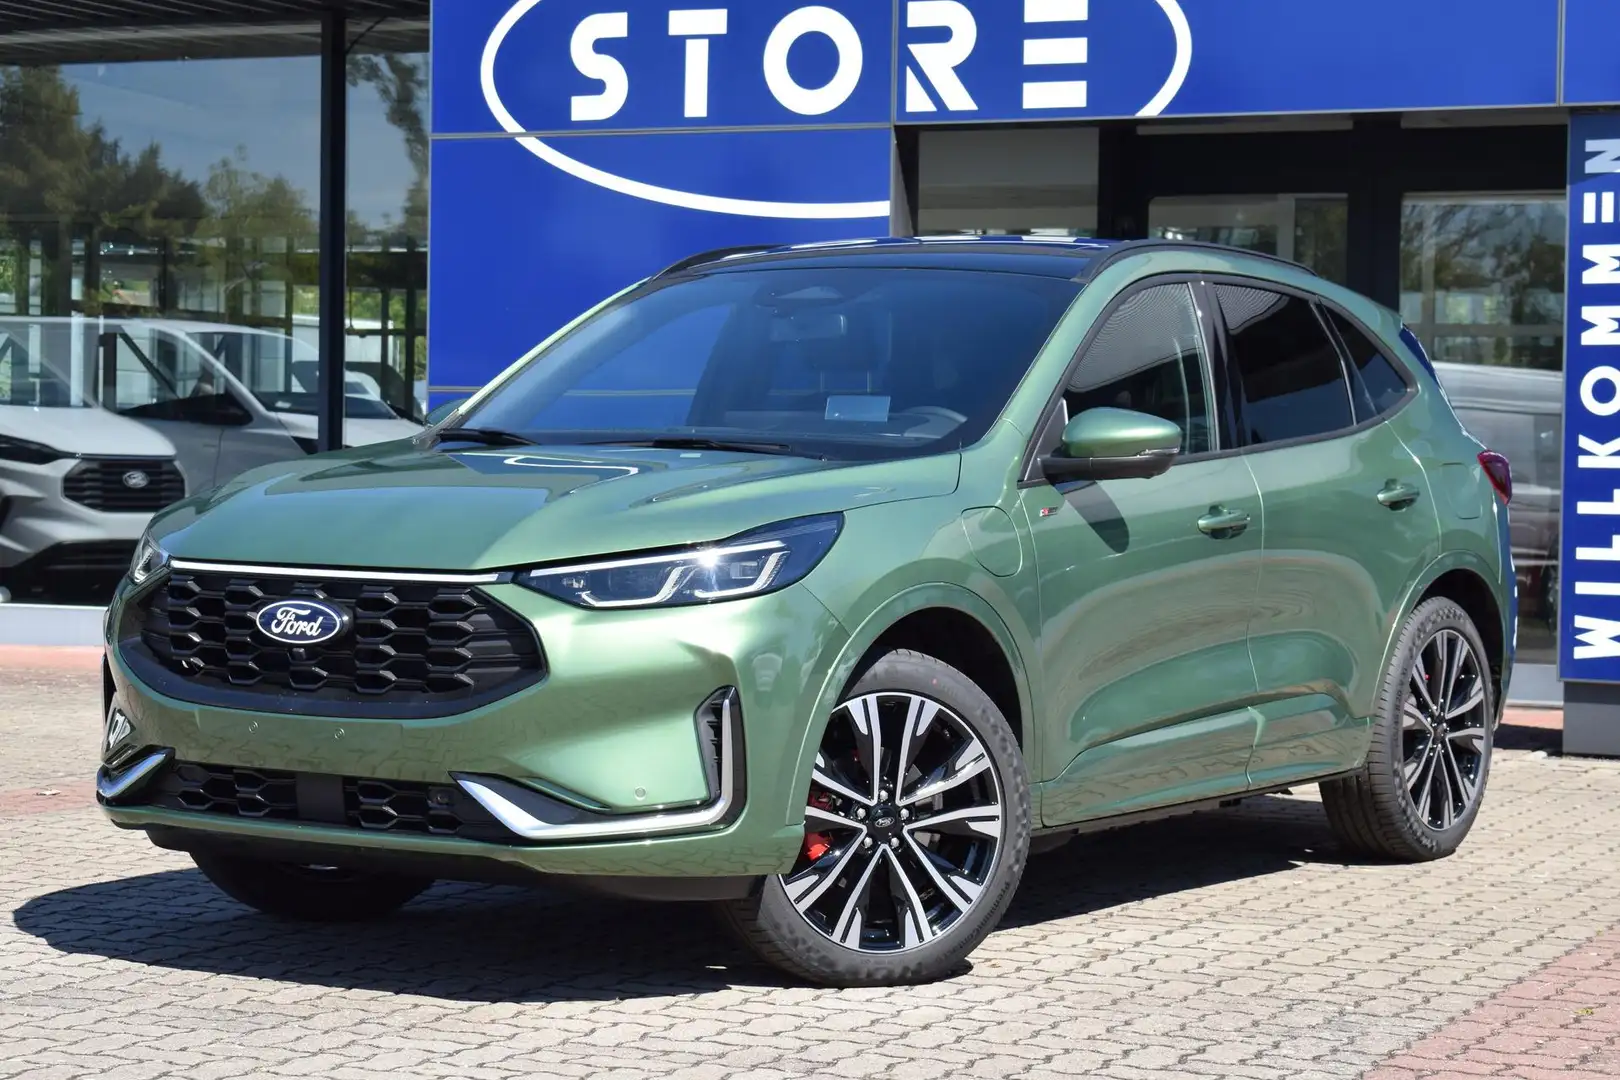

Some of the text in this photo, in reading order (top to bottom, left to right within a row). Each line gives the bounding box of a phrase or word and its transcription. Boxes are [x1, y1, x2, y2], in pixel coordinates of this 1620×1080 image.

[571, 0, 1089, 121] STORE
[1573, 138, 1620, 660] WILLKOMMEN
[271, 607, 324, 637] Ford
